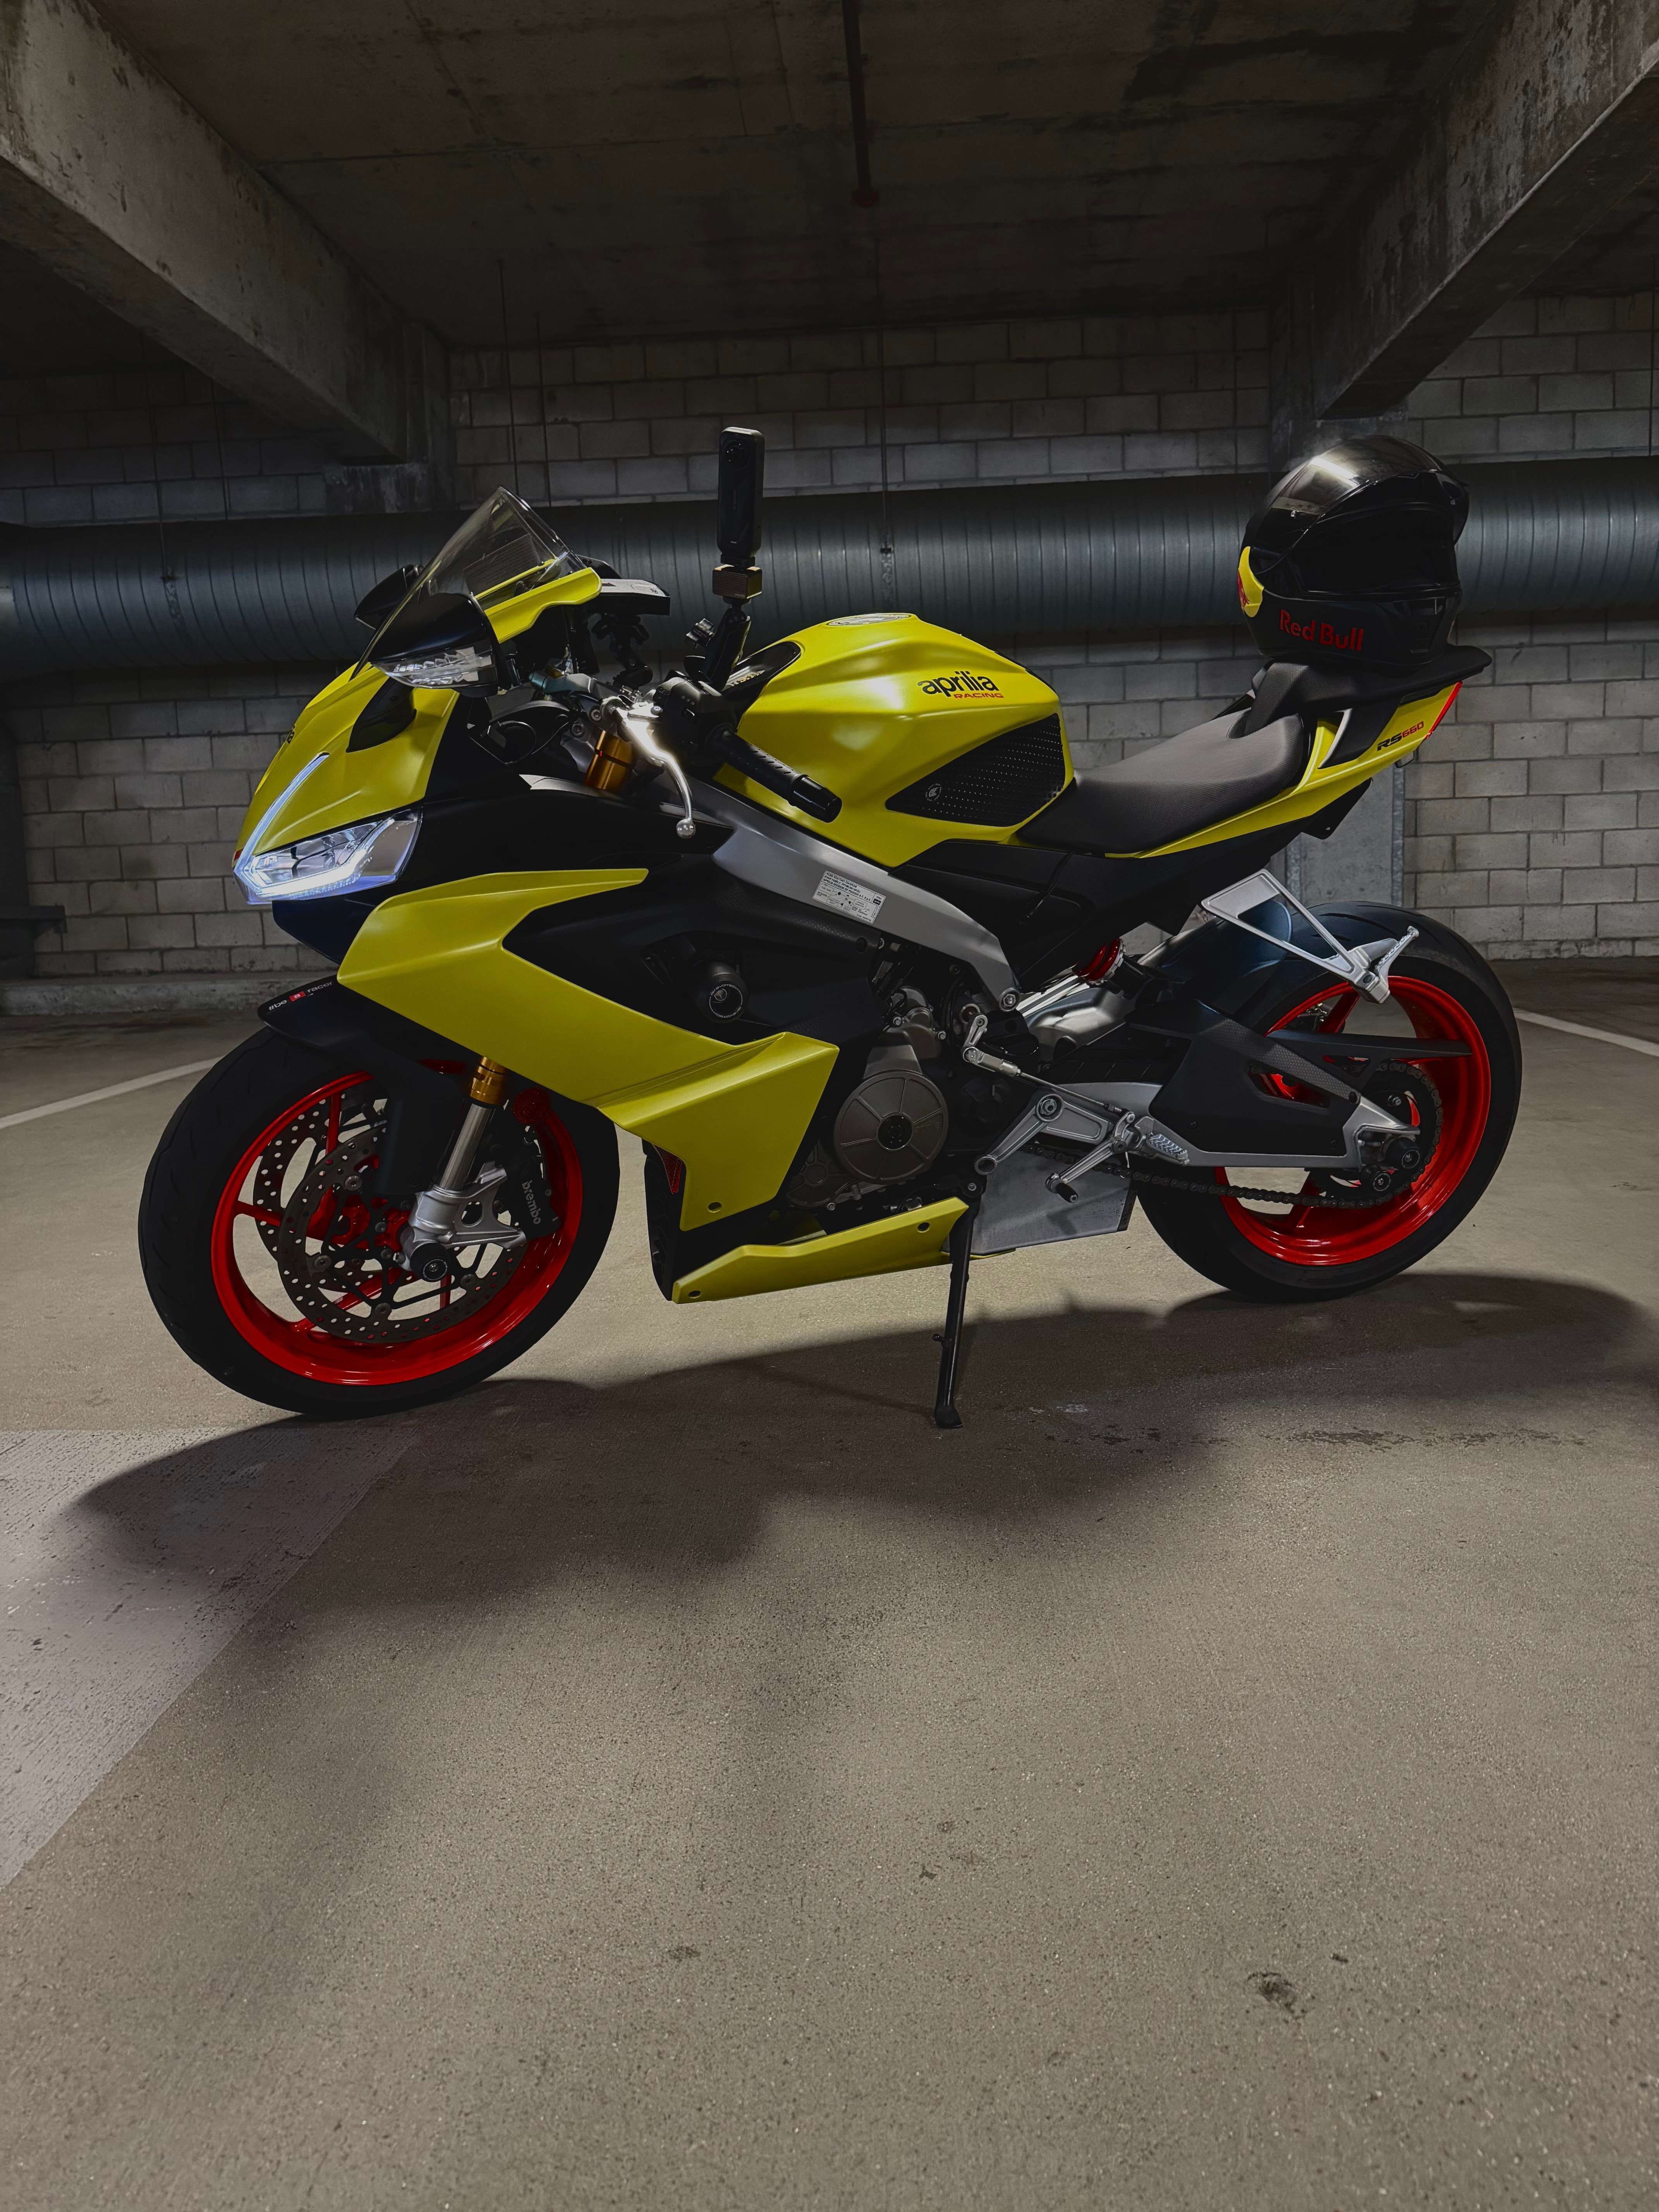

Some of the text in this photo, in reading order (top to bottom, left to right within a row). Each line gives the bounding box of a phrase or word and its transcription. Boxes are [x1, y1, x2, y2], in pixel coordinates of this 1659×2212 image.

[1279, 610, 1364, 651] Red Bull
[917, 671, 999, 697] aprilia
[307, 981, 333, 993] racer
[522, 1180, 541, 1224] brembo
